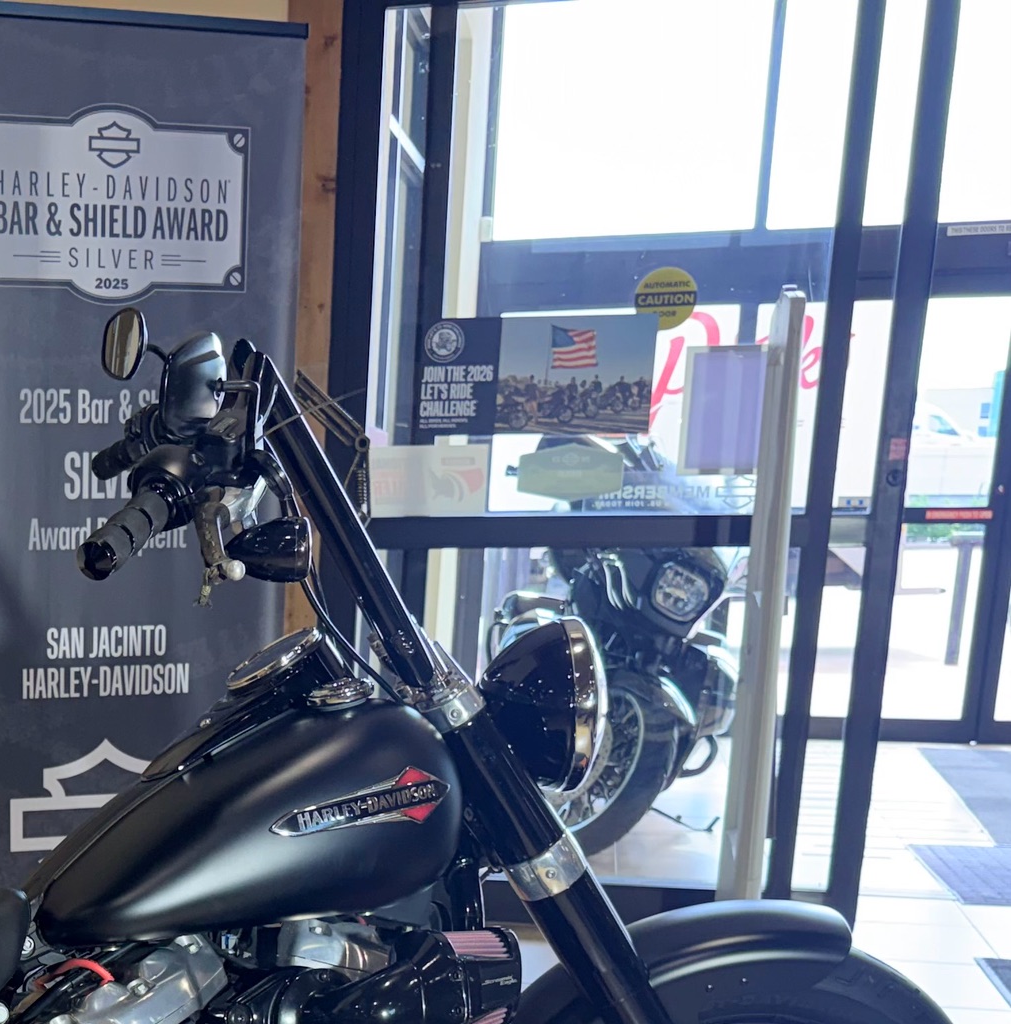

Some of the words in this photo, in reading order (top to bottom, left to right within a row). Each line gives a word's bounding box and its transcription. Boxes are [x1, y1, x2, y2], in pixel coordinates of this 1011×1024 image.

[45, 202, 63, 237] &
[68, 203, 147, 240] SHIELD
[151, 206, 229, 242] AWARD
[68, 247, 155, 270] SILVER
[94, 277, 129, 290] 2025
[643, 280, 691, 290] AUTOMATIC
[637, 293, 695, 306] CAUTION
[421, 366, 446, 383] JOIN
[446, 366, 467, 383] THE
[467, 365, 494, 382] 2026
[420, 383, 449, 400] LET'S
[449, 383, 475, 400] RIDE
[19, 388, 72, 424] 2025
[77, 389, 114, 424] Bar
[118, 389, 132, 424] &
[419, 400, 477, 417] CHALLENGE
[46, 627, 85, 660] SAN
[88, 624, 167, 659] JACINTO
[22, 662, 190, 699] HARLEY-DAVIDSON
[296, 783, 436, 831] HARLEY-DAVIDSON
